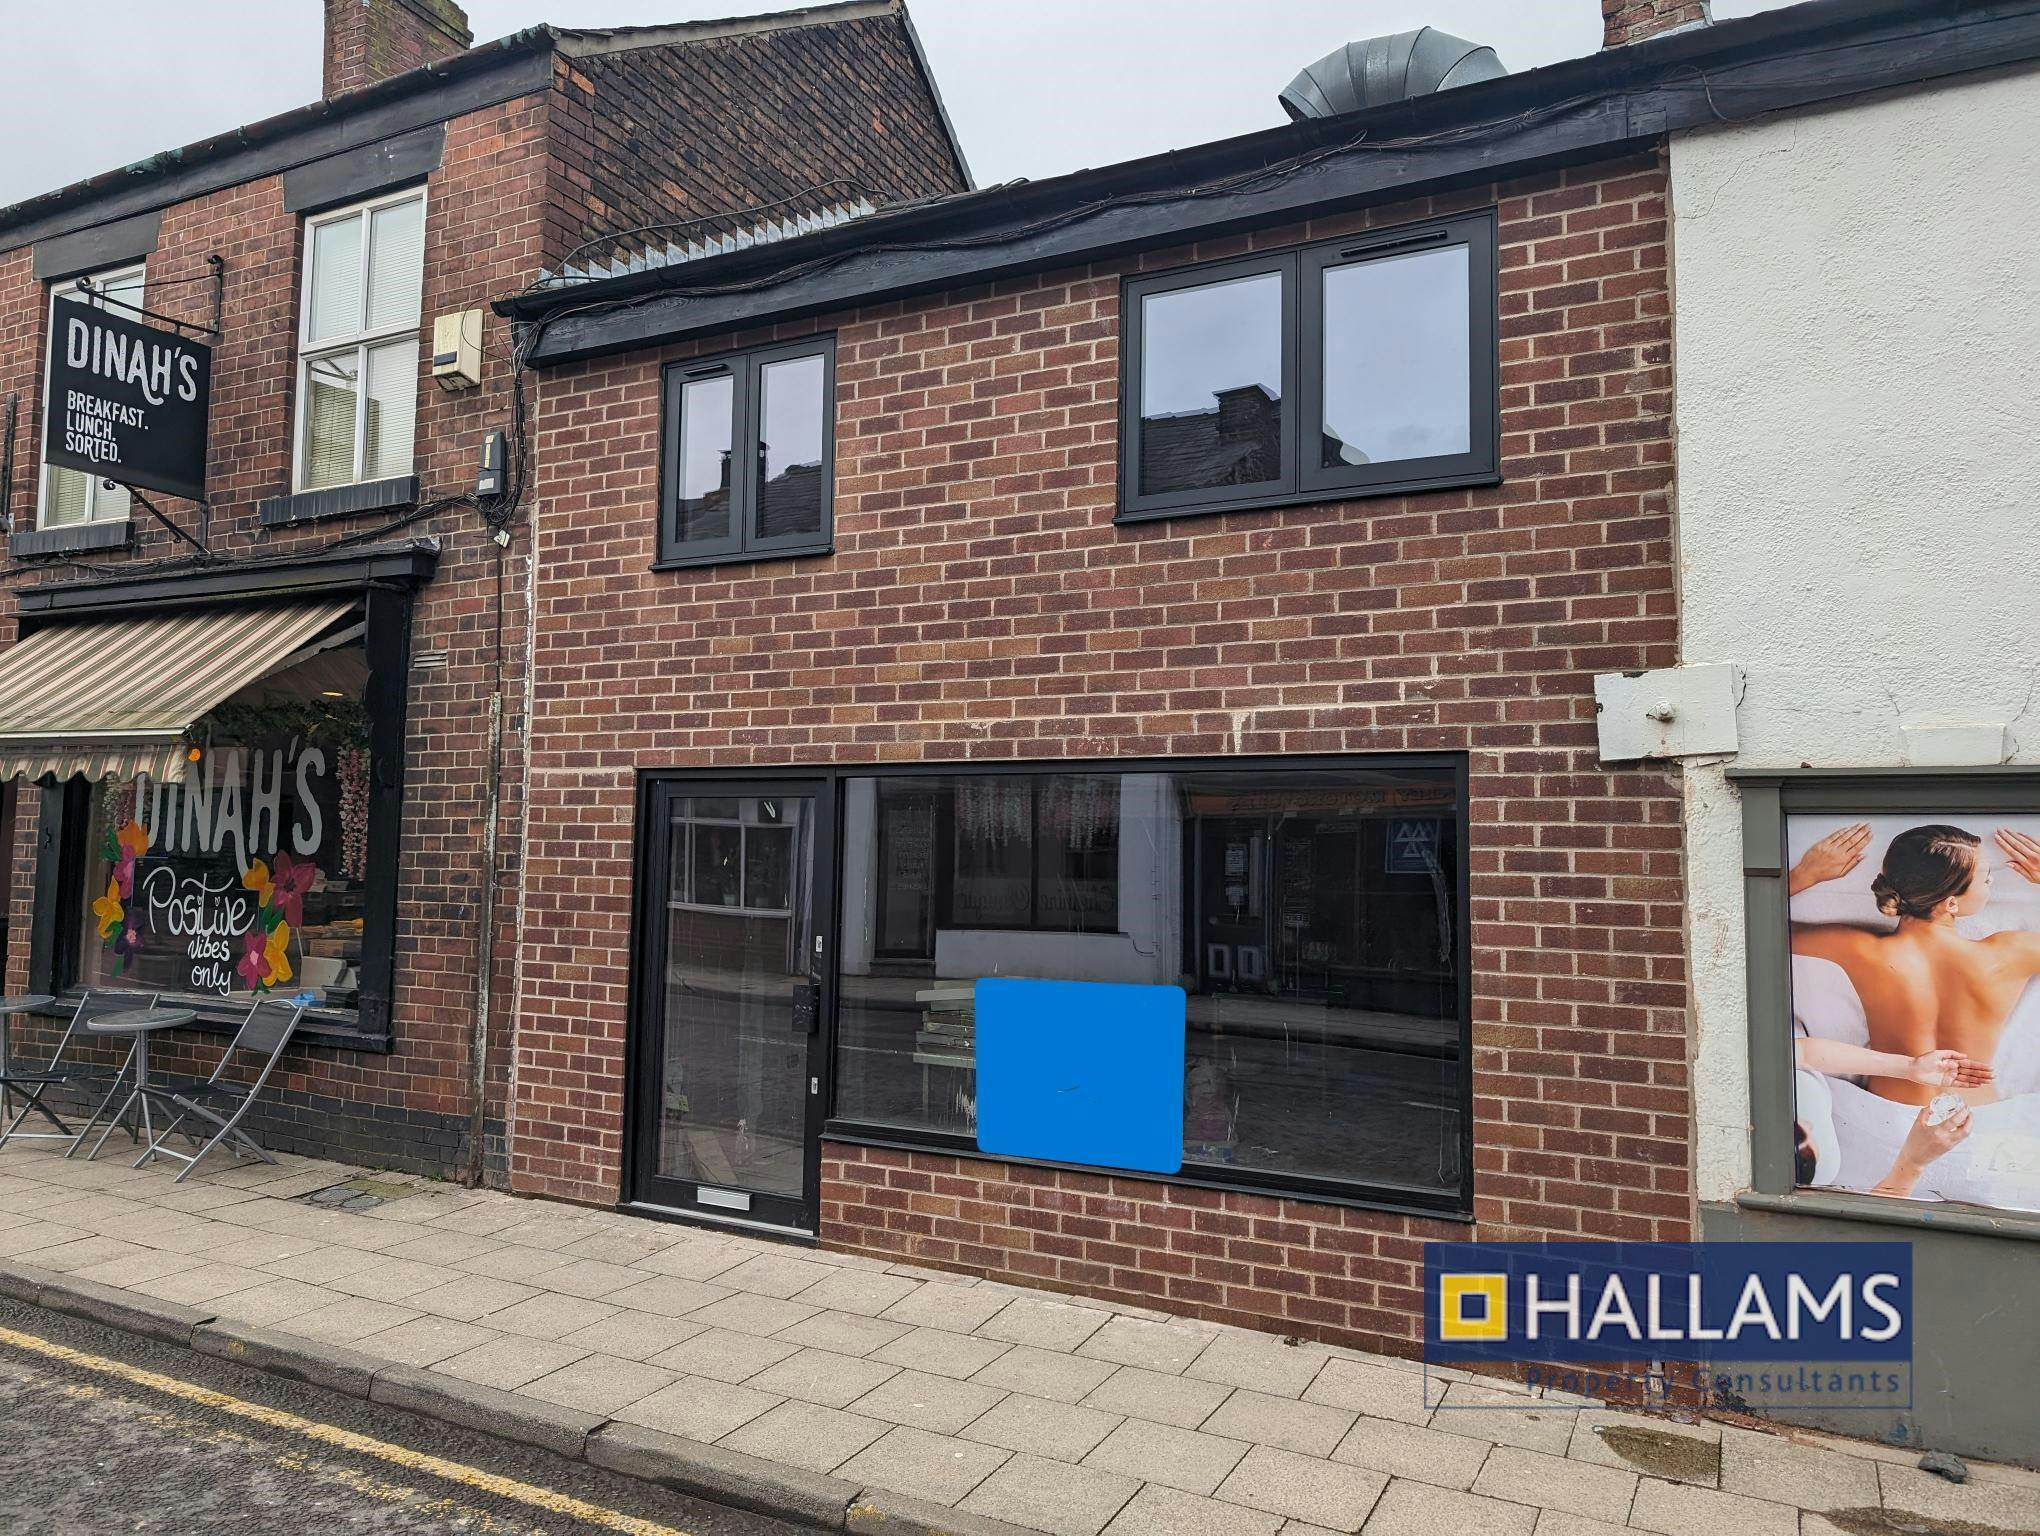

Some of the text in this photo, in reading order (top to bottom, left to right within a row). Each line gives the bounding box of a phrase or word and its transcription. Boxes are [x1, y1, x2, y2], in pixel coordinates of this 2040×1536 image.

[67, 317, 198, 406] DINAH'S
[66, 410, 117, 442] LUNCH.
[67, 389, 149, 430] BREAKFAST.
[65, 431, 122, 463] SORTED.
[142, 866, 256, 936] Positive
[191, 961, 232, 997] only
